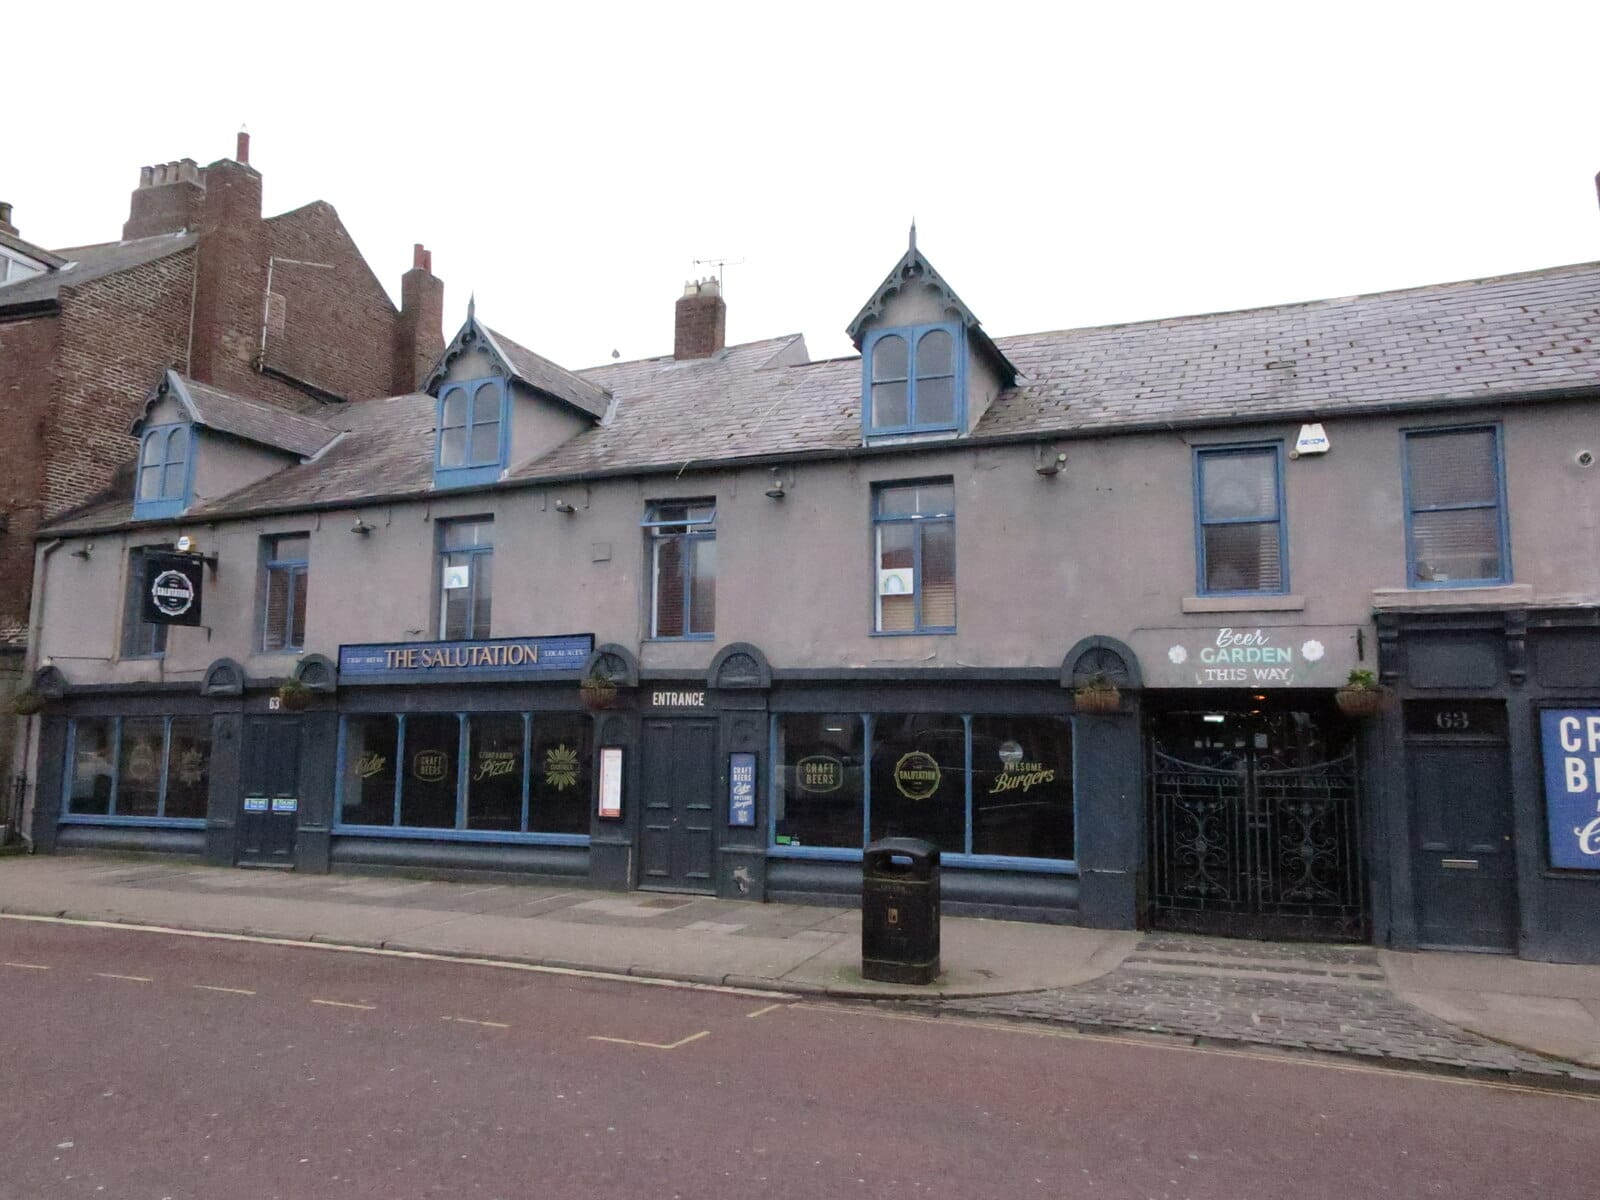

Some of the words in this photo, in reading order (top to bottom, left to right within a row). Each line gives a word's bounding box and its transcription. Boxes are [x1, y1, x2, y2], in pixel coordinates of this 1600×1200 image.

[1216, 627, 1269, 648] Beer
[384, 648, 418, 669] THE
[421, 644, 538, 668] SALUTATION
[1200, 647, 1292, 663] GARDEN
[1205, 667, 1248, 681] THIS
[1253, 667, 1290, 680] WAY
[269, 696, 280, 710] 63
[652, 691, 705, 706] ENTRANCE
[1436, 711, 1470, 729] 63
[472, 758, 515, 781] Pizza
[805, 763, 834, 773] CRAFT
[806, 774, 834, 785] BEERS
[989, 769, 1055, 794] Burgers
